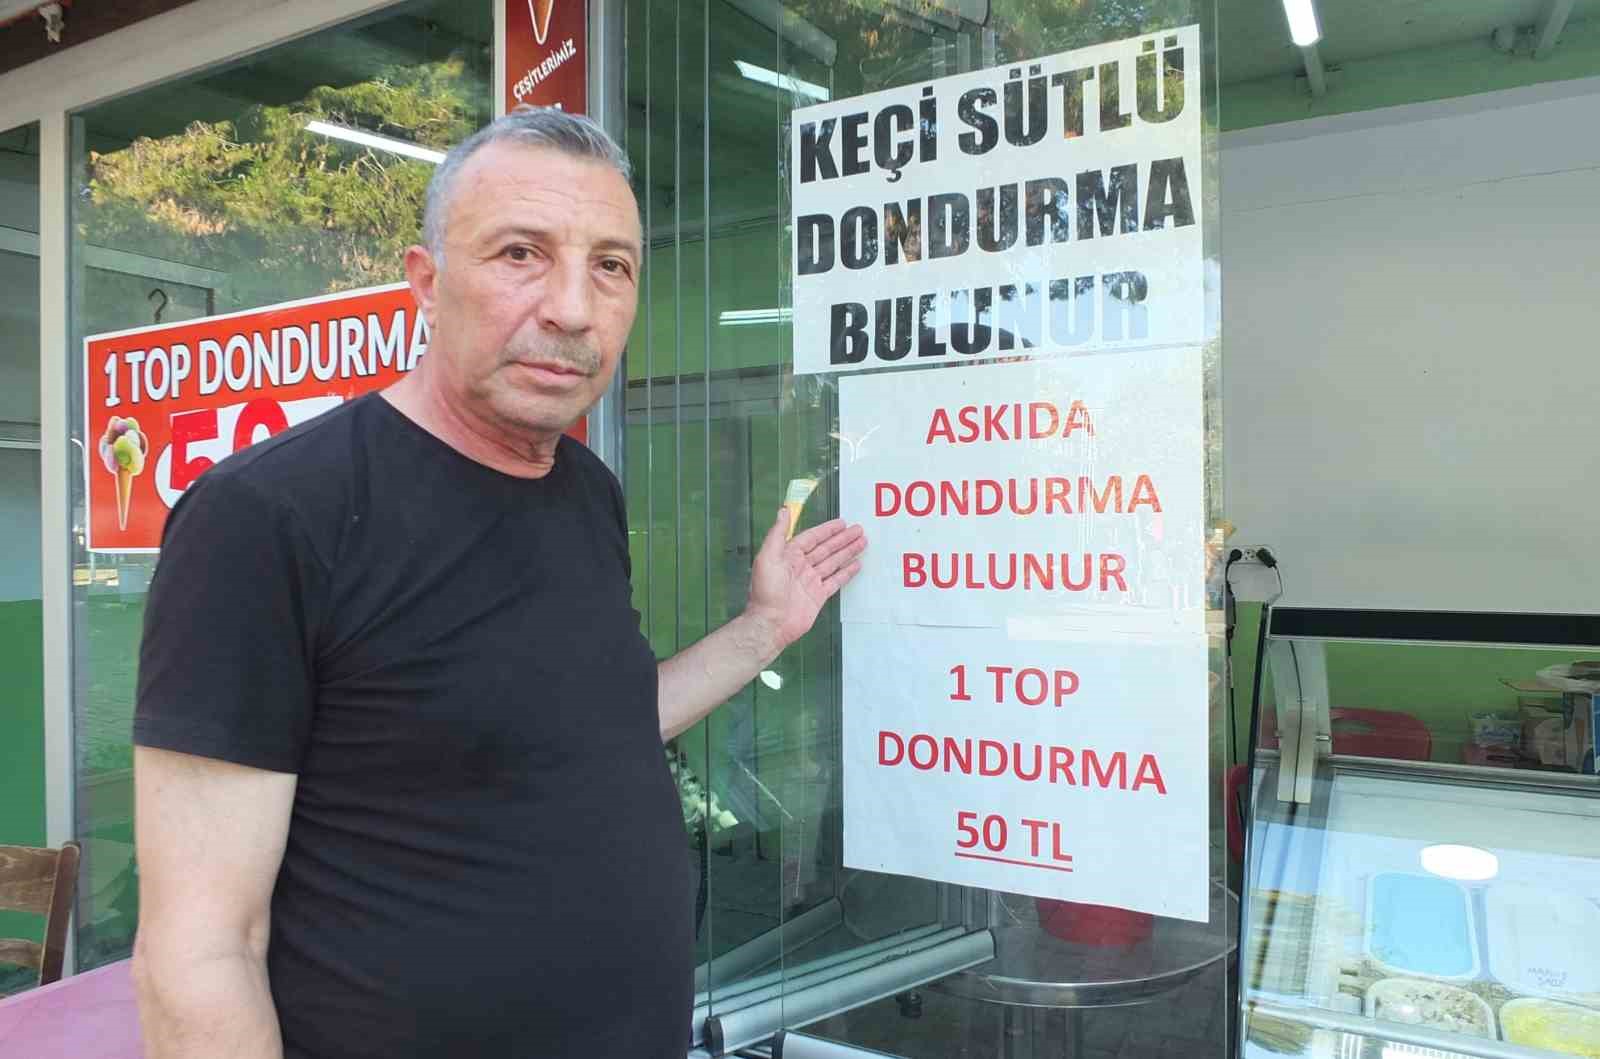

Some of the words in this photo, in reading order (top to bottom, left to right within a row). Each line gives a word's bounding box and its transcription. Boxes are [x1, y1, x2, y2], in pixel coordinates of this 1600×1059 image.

[513, 38, 576, 102] ÇEŞİTLERİMİZ
[800, 86, 937, 183] KEÇİ
[957, 36, 1185, 156] SÜTLÜ
[797, 157, 1196, 276] DONDURMA
[829, 270, 1149, 365] BULUNUR
[104, 352, 121, 408] 1
[125, 343, 192, 404] TOP
[926, 400, 1095, 445] ASKIDA
[874, 474, 1163, 518] DONDURMA
[903, 552, 1128, 592] BULUNUR
[950, 664, 971, 701] 1
[986, 665, 1080, 708] TOP
[878, 730, 1167, 795] DONDURMA
[955, 811, 1008, 852] 50
[1021, 818, 1073, 862] TL
